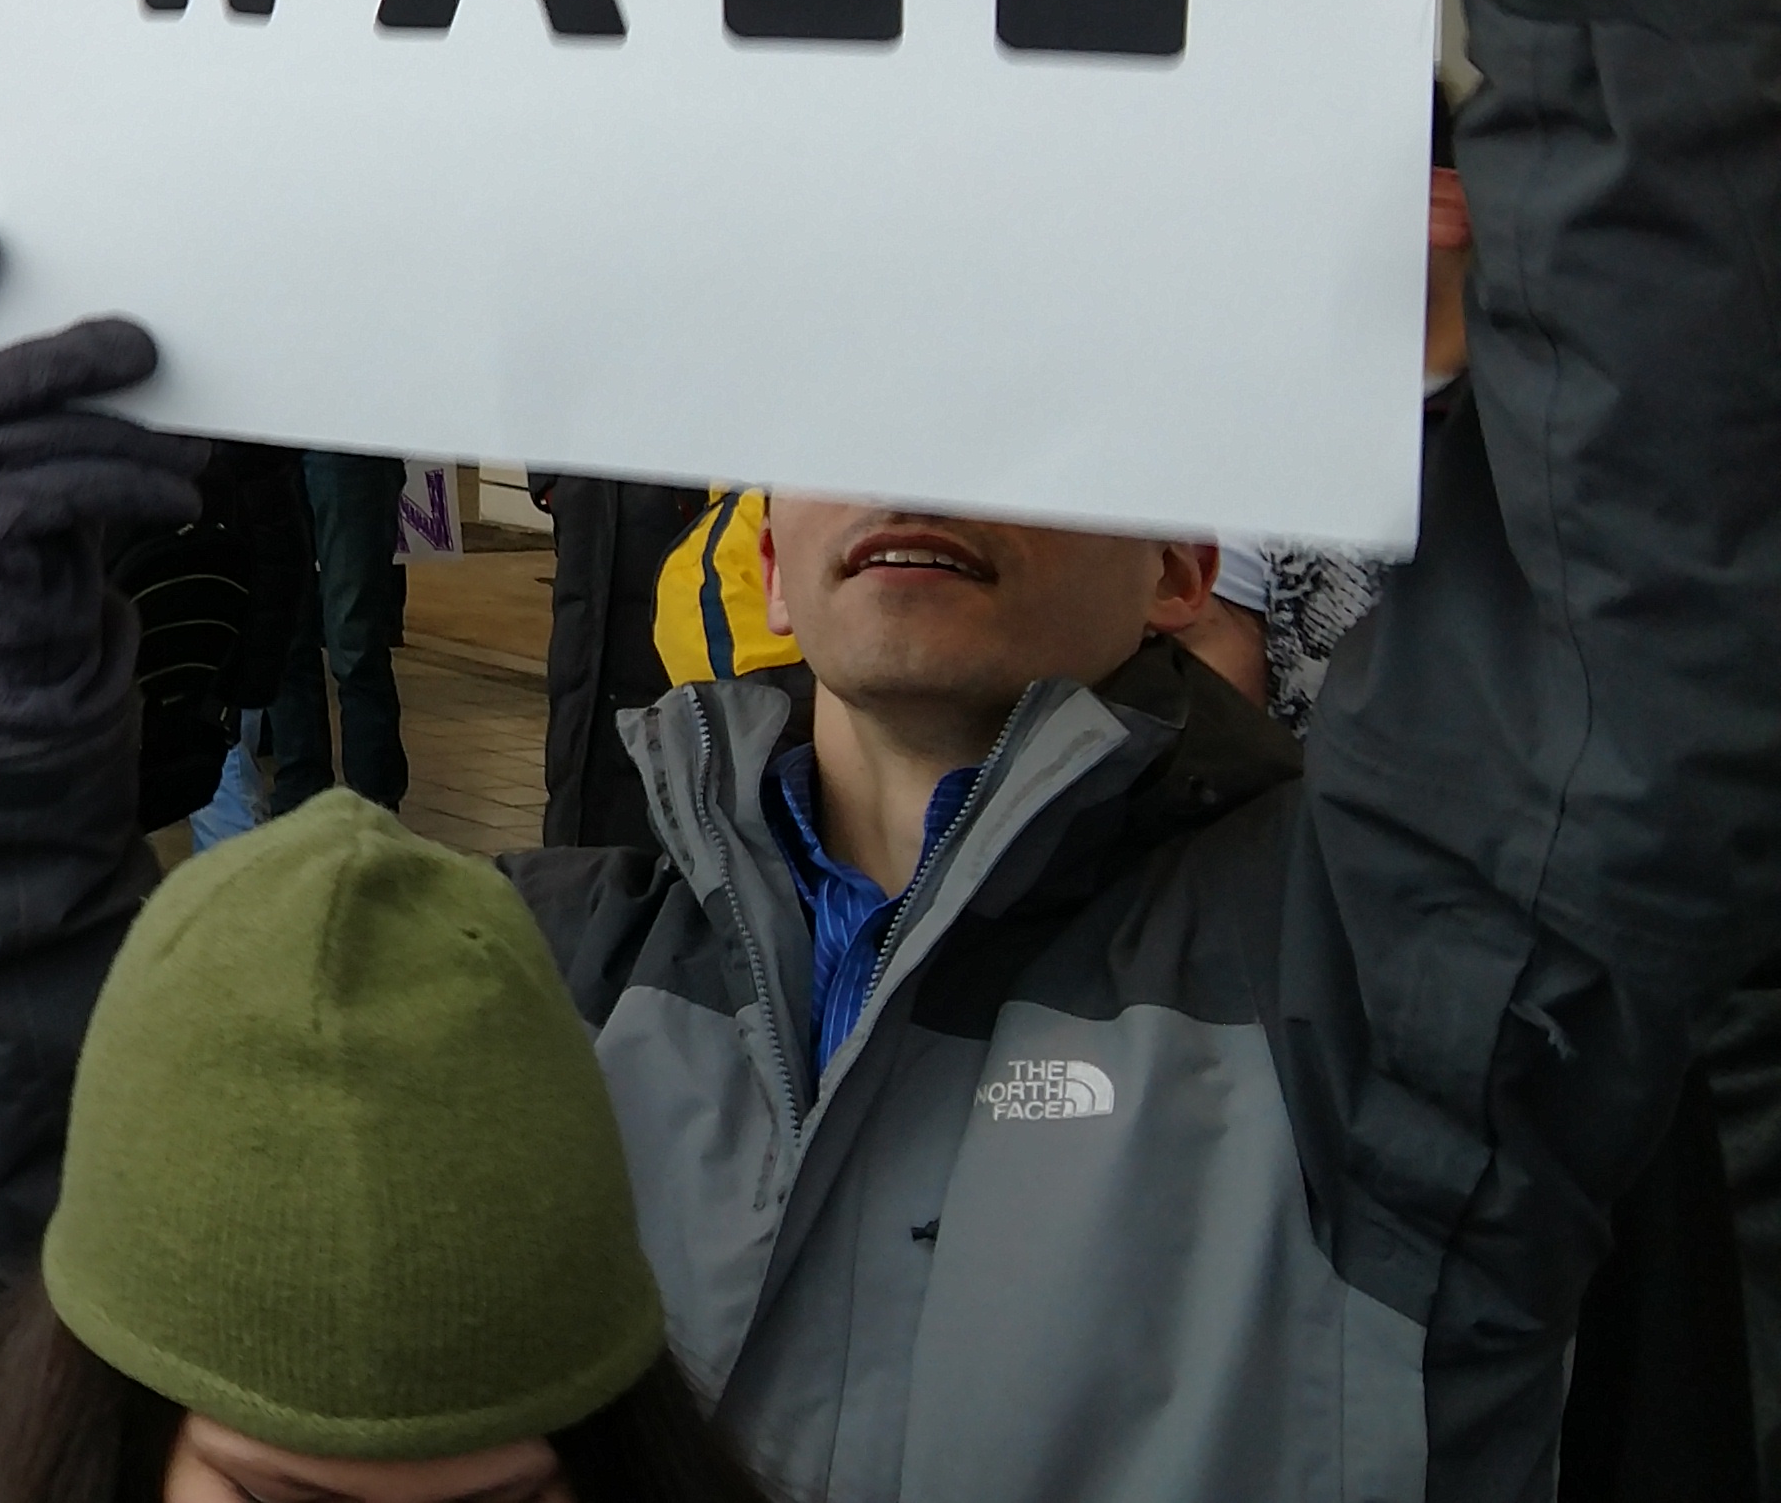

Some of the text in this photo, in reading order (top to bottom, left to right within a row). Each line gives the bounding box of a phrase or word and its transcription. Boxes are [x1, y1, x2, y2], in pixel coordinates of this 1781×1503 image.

[1008, 1059, 1066, 1080] THE
[973, 1079, 1066, 1108] NORTH
[993, 1100, 1064, 1121] FACE
